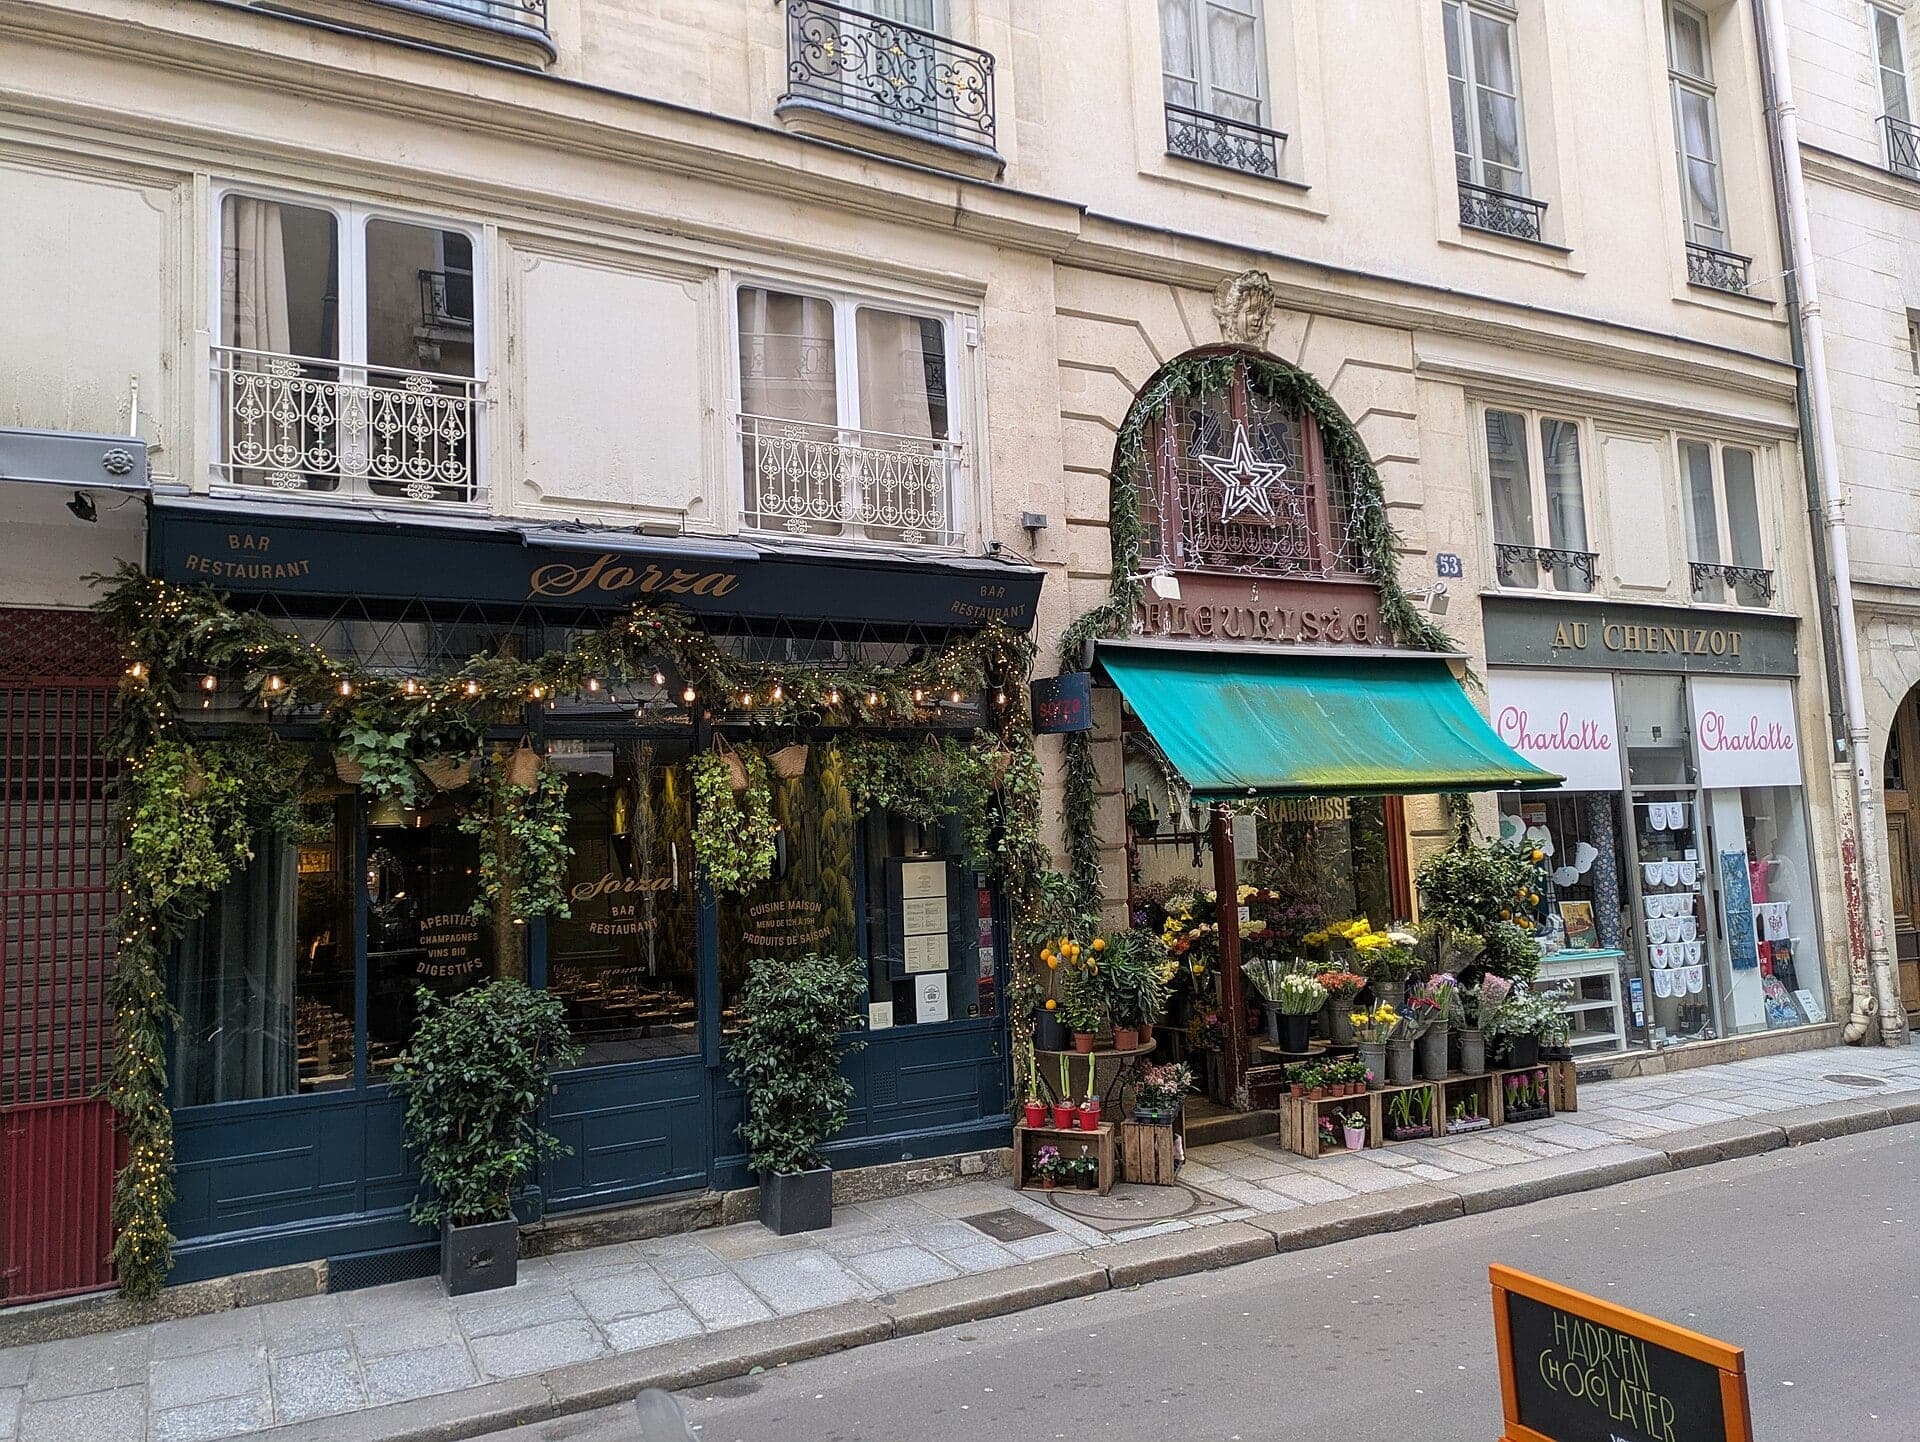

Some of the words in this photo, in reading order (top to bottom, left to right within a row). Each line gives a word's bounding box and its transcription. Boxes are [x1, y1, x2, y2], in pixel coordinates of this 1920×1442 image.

[228, 534, 270, 551] BAR
[185, 554, 310, 579] RESTAURANT
[1440, 555, 1459, 574] 53
[526, 553, 741, 600] Sorza
[980, 585, 1006, 599] BAR
[951, 600, 1026, 618] RESTAURANT
[1551, 621, 1589, 650] AU
[1602, 624, 1743, 657] CHENIZOT
[1497, 705, 1612, 751] Charlotte
[1699, 710, 1794, 751] Charlotte
[570, 872, 672, 903] Sorza
[611, 905, 635, 917] BAR
[750, 901, 786, 917] CUISINE
[787, 899, 822, 913] MAISON
[420, 913, 479, 931] APERITIFS
[589, 917, 658, 935] RESTAURANT
[420, 932, 479, 945] CHAMPAGNES
[742, 931, 785, 947] PRODUITS
[786, 935, 798, 946] DE
[799, 926, 831, 944] SAISON
[427, 947, 449, 958] VINS
[451, 947, 466, 957] BIO
[416, 958, 483, 977] DIGESTIFS
[1552, 1311, 1651, 1391] HADRIEN
[1539, 1349, 1675, 1442] CHOCOLATIER
